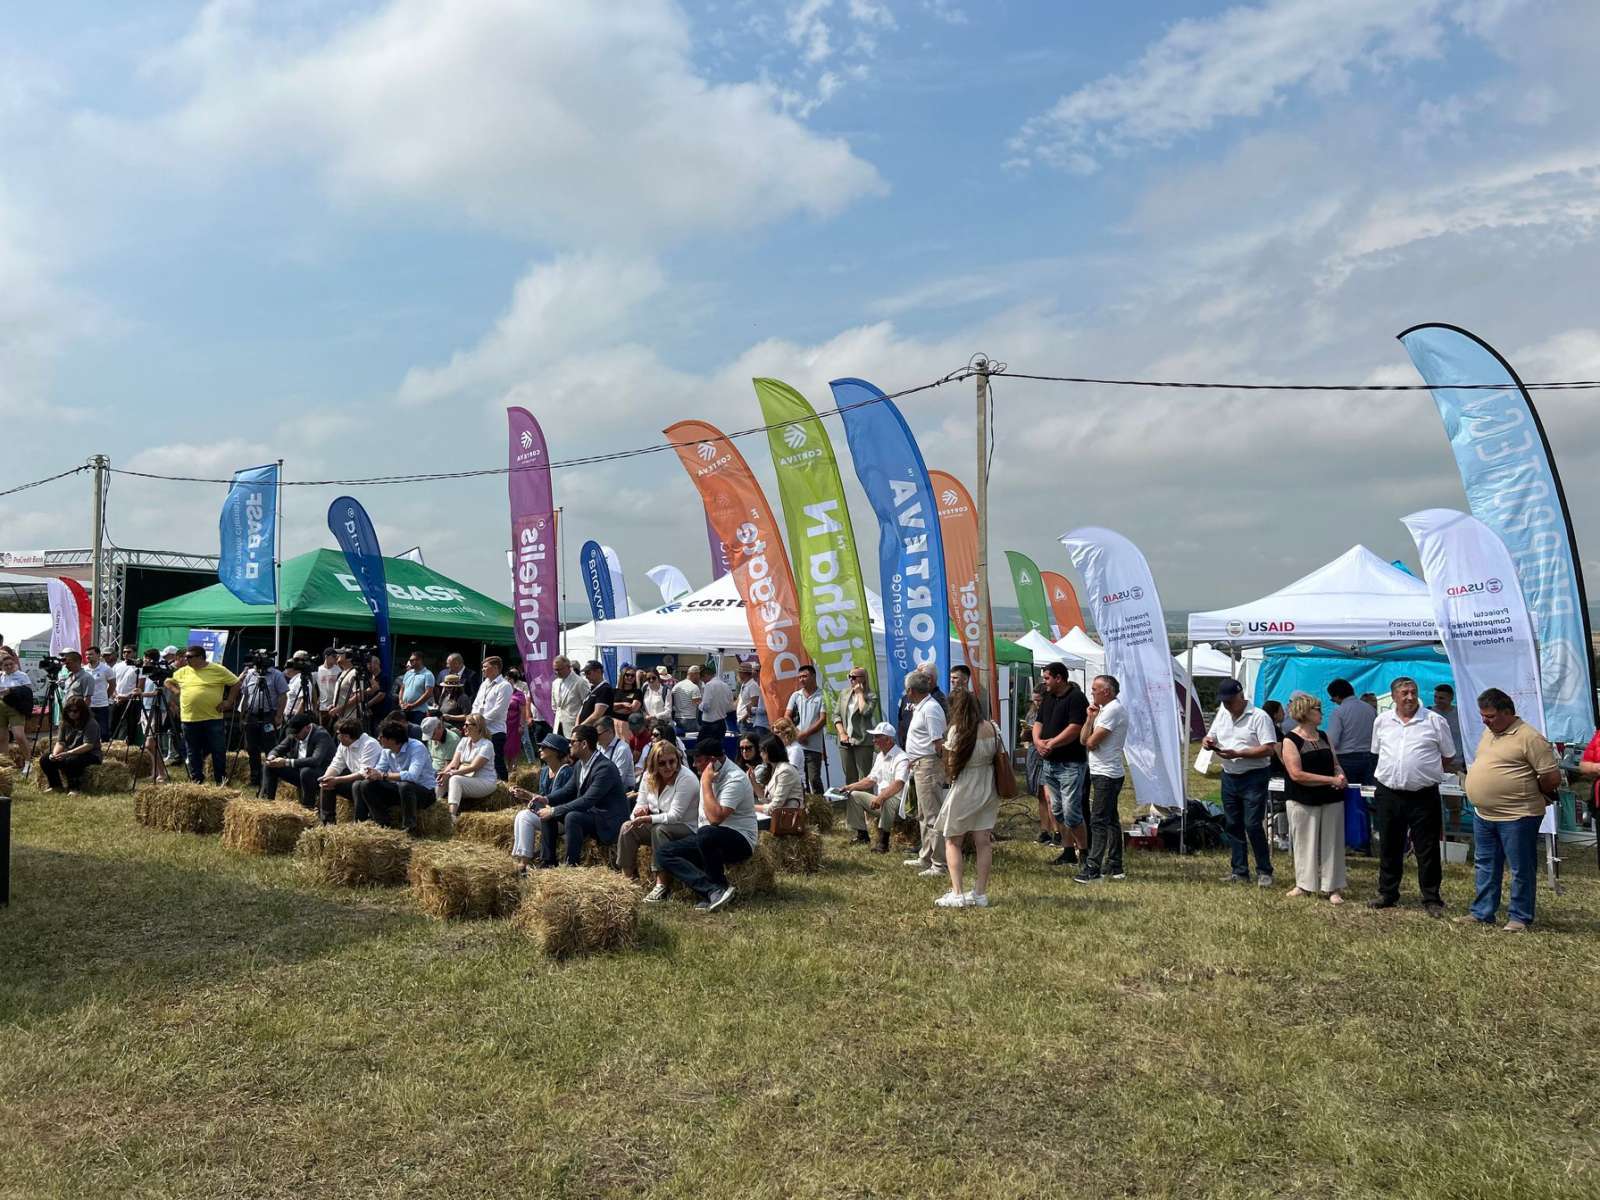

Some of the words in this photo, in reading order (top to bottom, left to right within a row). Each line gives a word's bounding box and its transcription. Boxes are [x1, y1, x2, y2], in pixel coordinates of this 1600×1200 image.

[386, 585, 467, 603] BASF
[688, 598, 748, 608] CORTE
[1248, 621, 1295, 632] USAID
[1389, 620, 1421, 628] Proiectul
